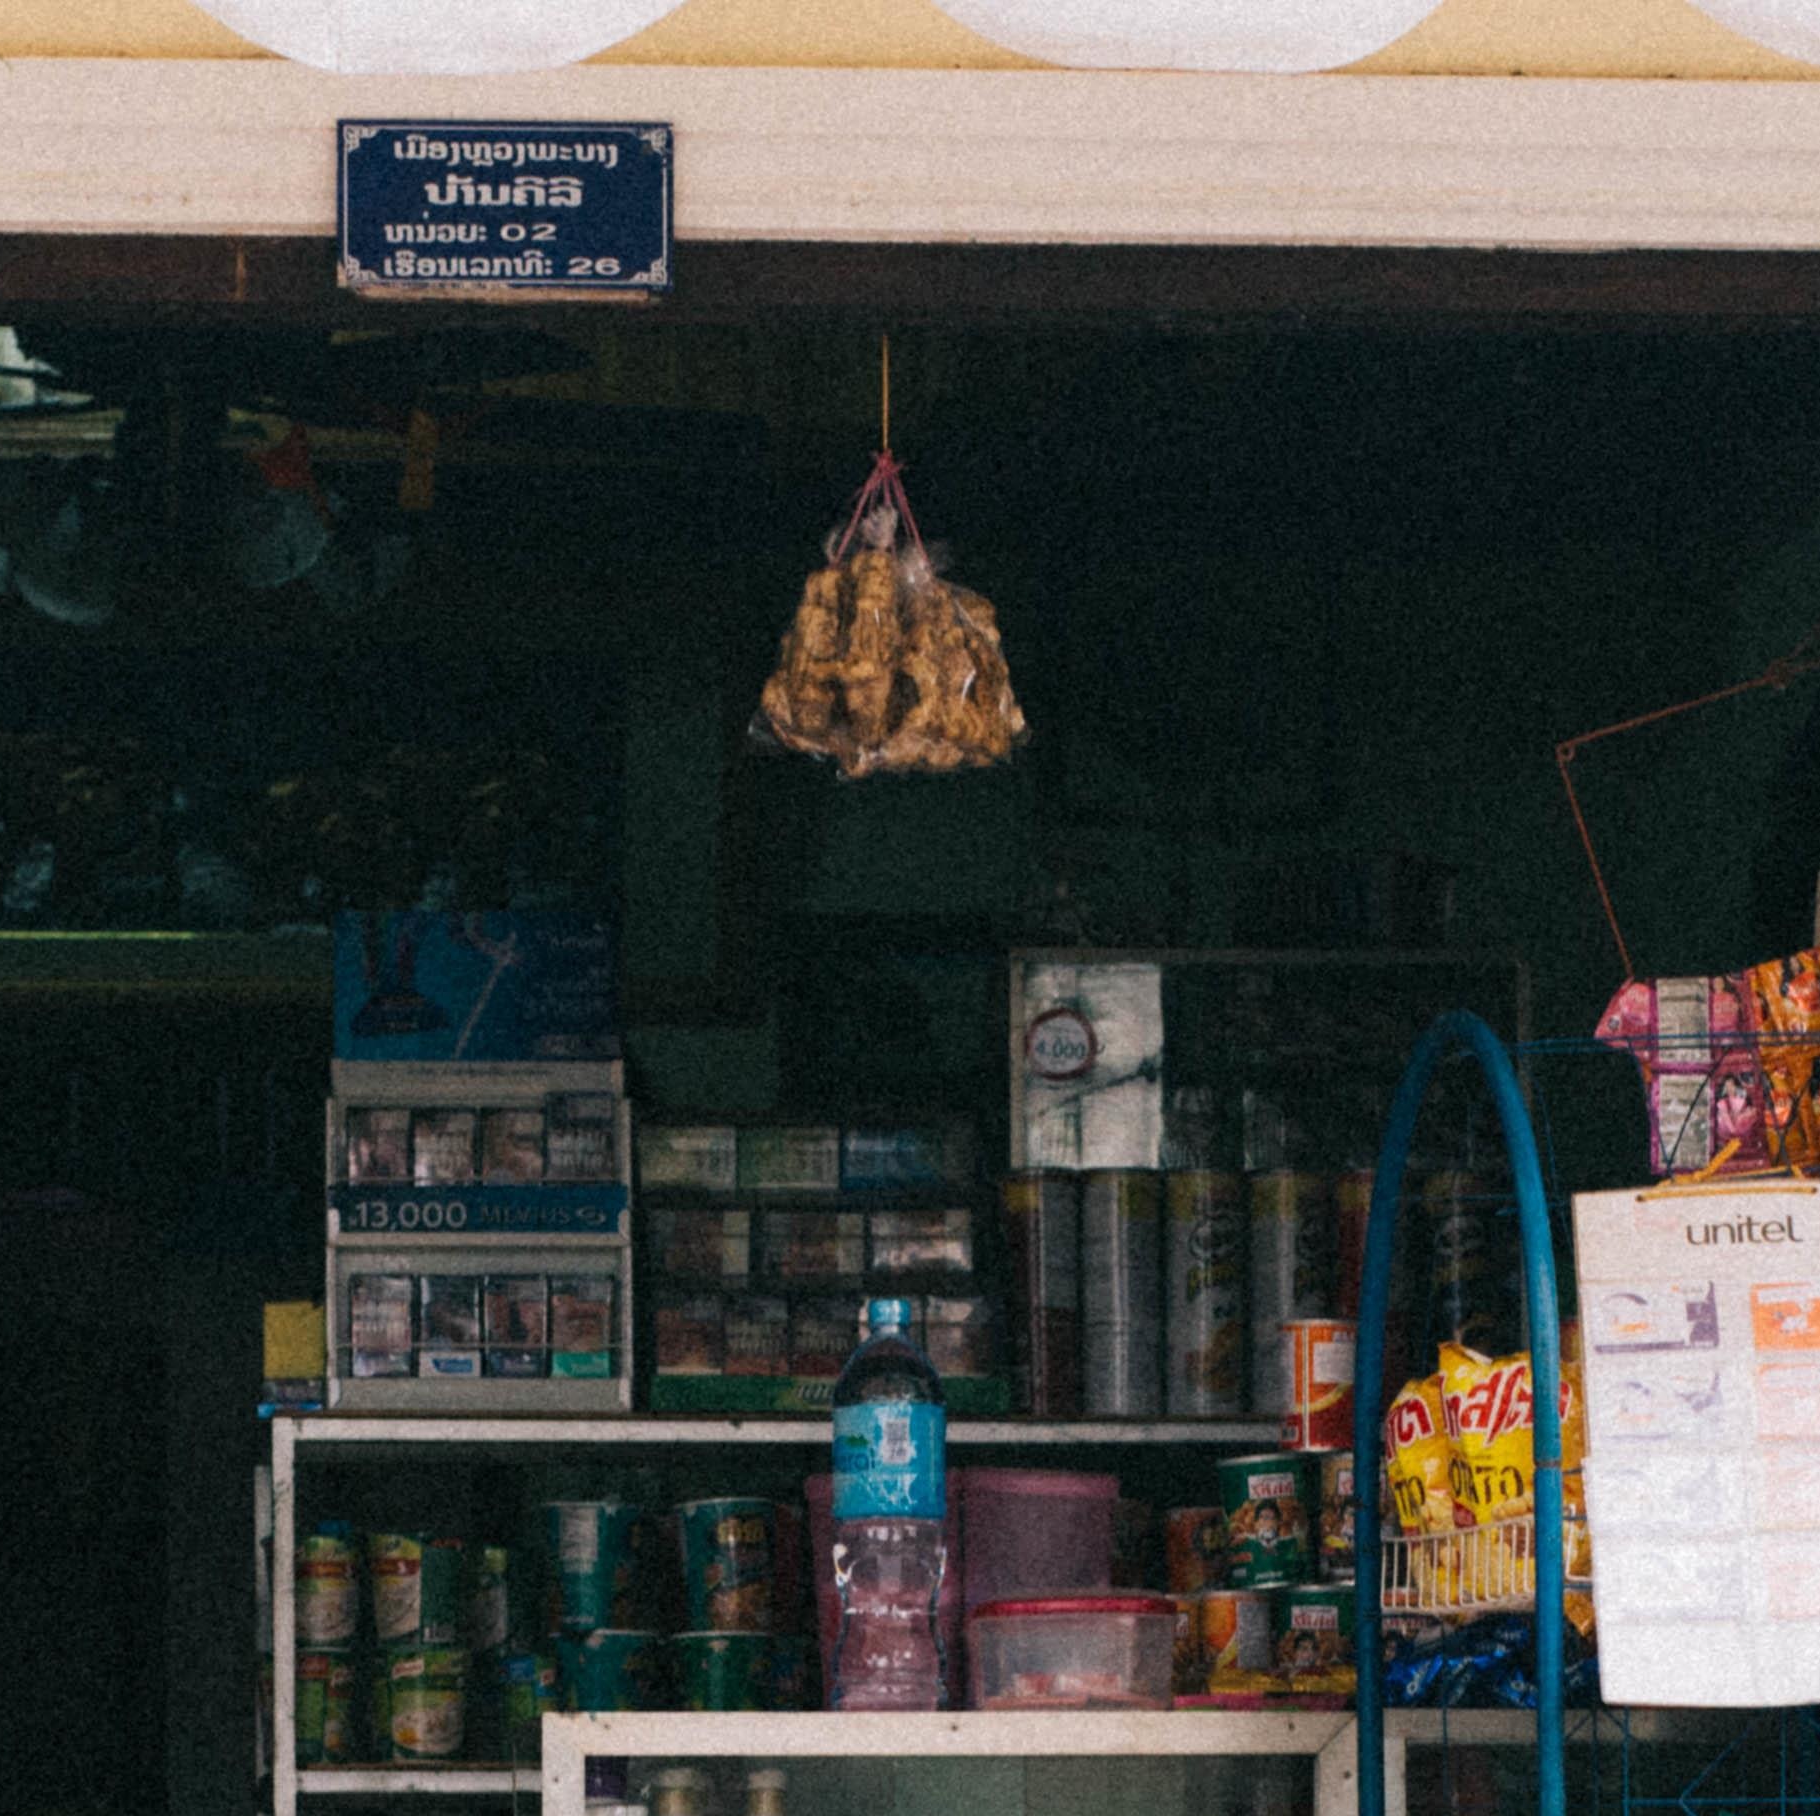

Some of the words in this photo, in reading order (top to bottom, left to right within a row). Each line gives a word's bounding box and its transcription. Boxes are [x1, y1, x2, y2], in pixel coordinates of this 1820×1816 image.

[500, 223, 557, 242] 02
[567, 257, 621, 275] 26
[1685, 1214, 1803, 1245] unitel
[1447, 1457, 1525, 1505] OTATO
